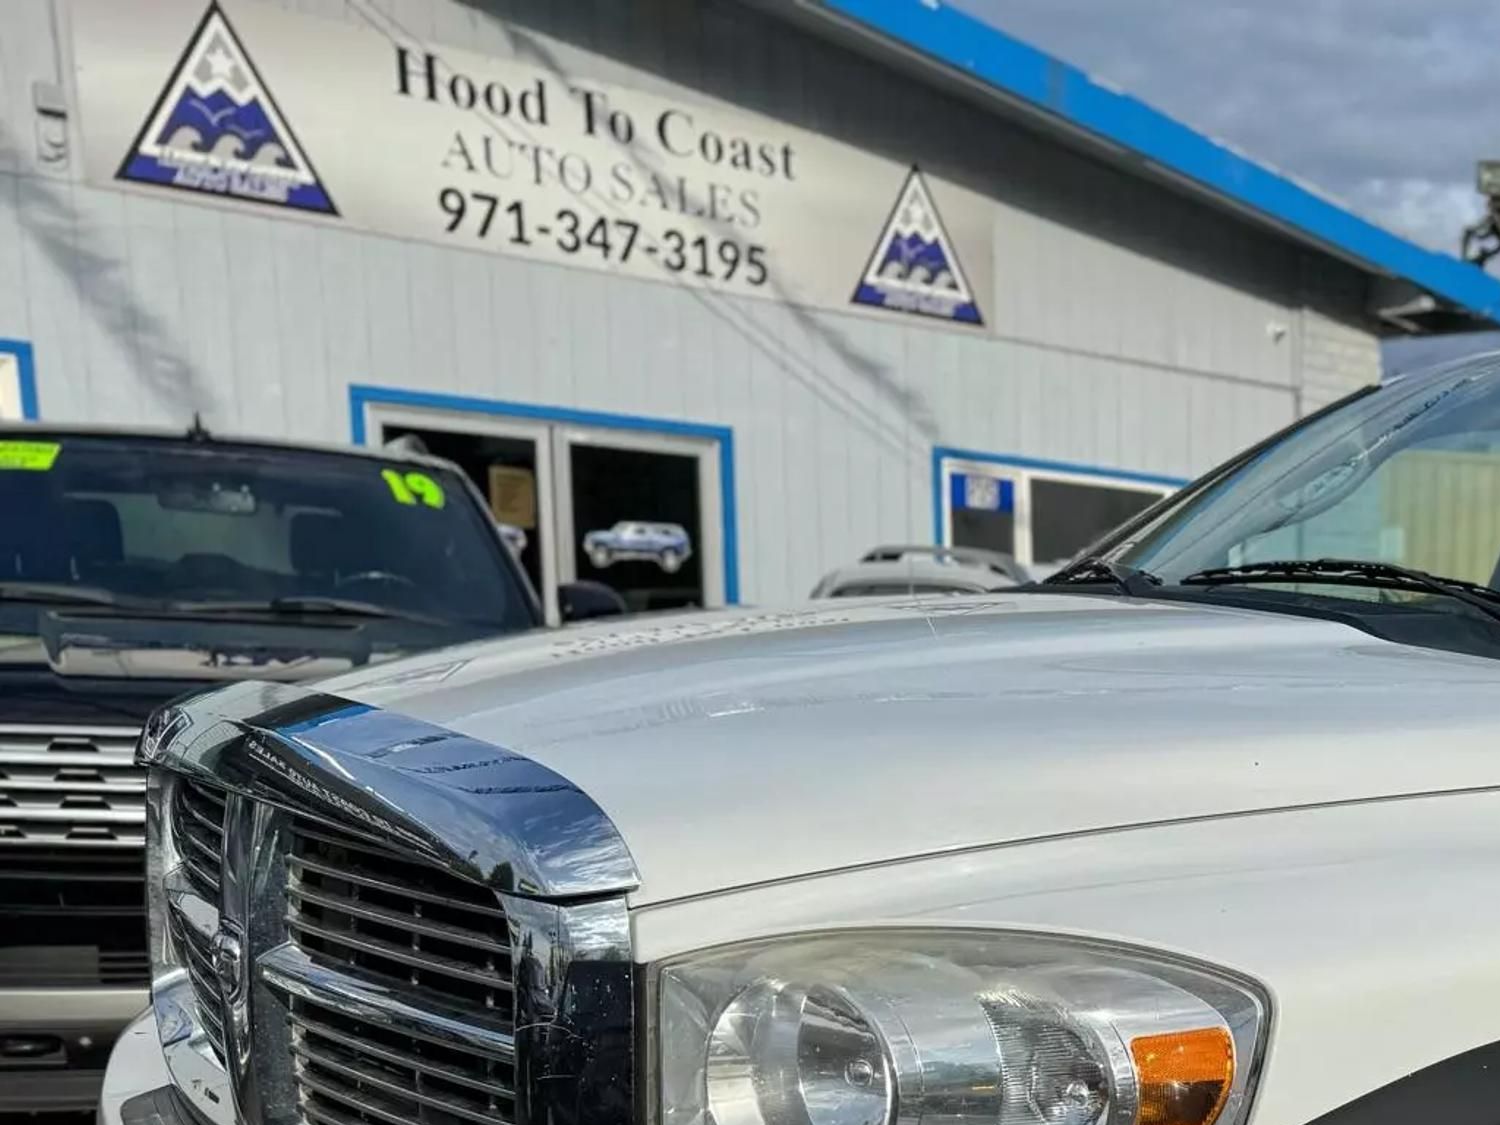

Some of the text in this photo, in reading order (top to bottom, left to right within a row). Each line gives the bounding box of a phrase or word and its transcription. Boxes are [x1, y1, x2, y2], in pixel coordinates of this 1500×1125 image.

[396, 47, 798, 181] Hood To Coast
[441, 131, 762, 229] AUTO SALES
[439, 188, 769, 286] 971-347-3195
[380, 469, 446, 509] 19
